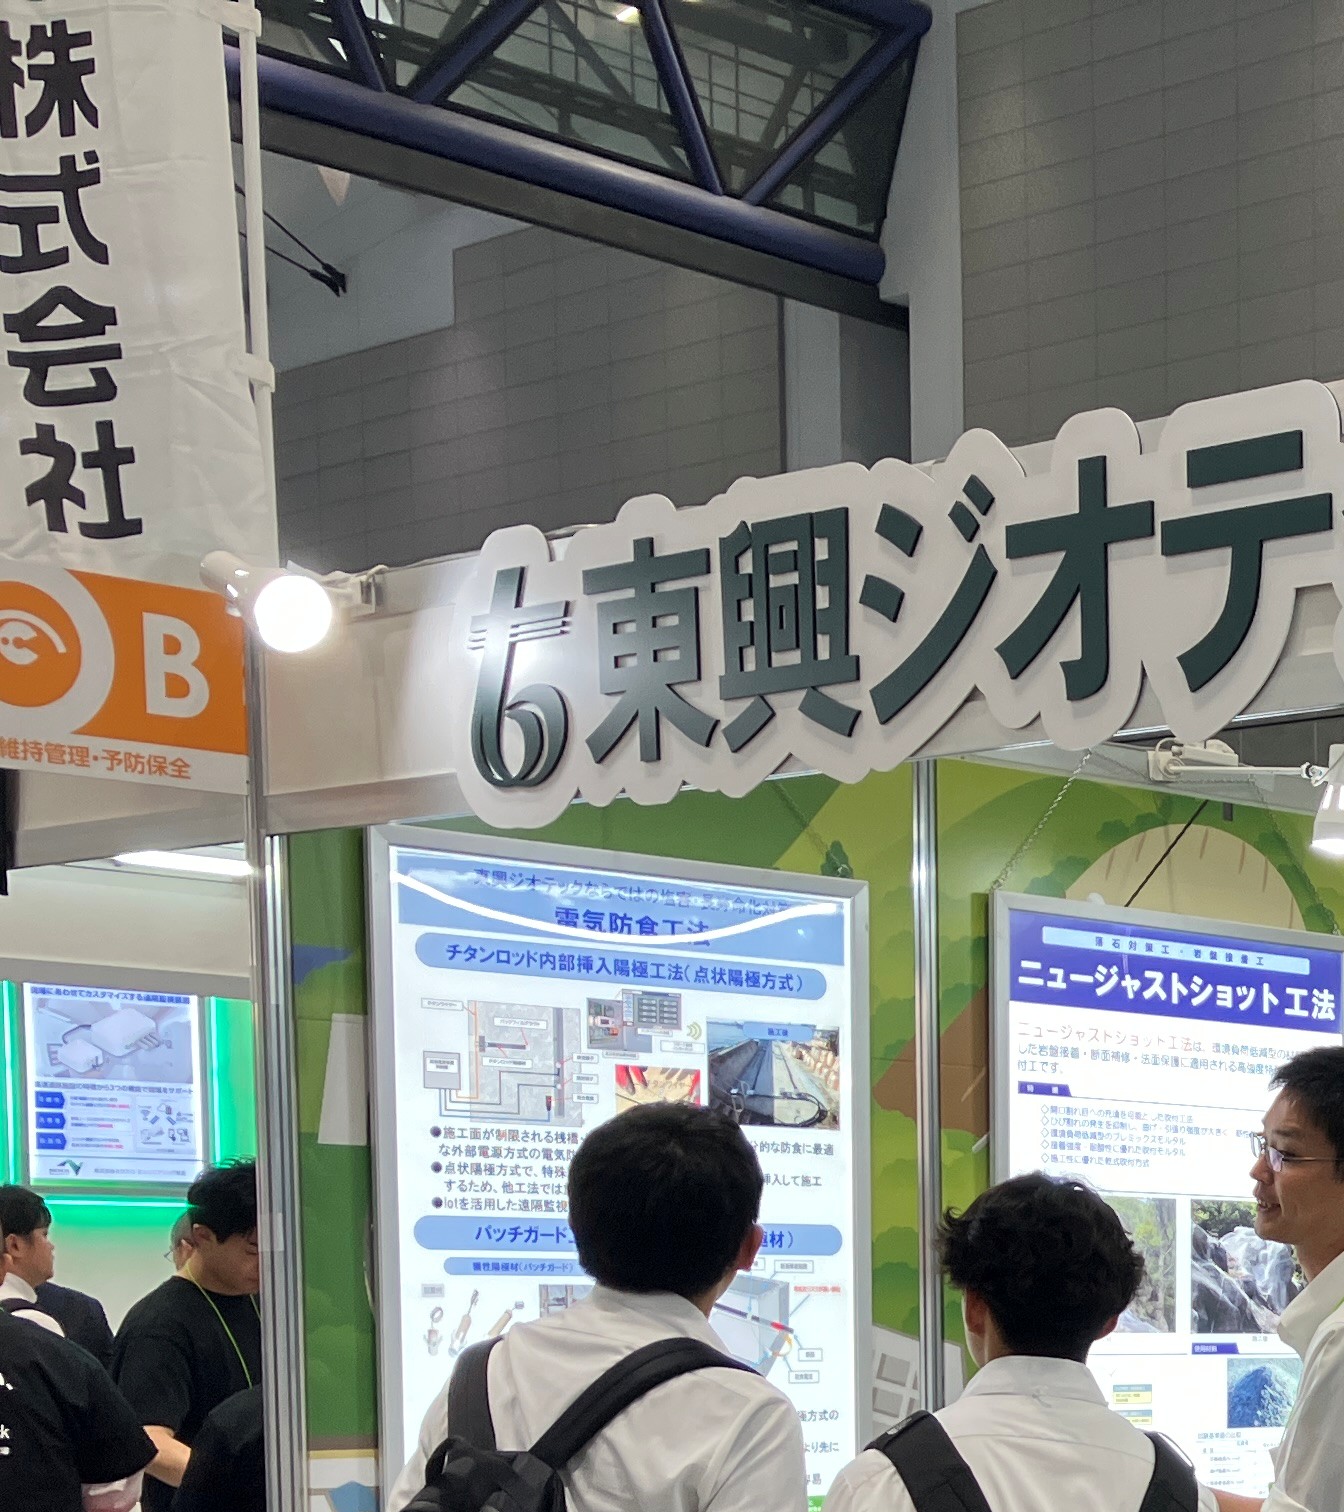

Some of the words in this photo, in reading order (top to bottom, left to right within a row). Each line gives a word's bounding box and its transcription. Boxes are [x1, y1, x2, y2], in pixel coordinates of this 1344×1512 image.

[0, 19, 143, 540] 株式会社
[143, 611, 210, 719] B
[0, 736, 192, 780] 維持管理・予防保全
[554, 905, 711, 947] 電気防食工法
[1017, 958, 1337, 1021] ニュージャストショット工法
[444, 1179, 569, 1196] するため、他工法では
